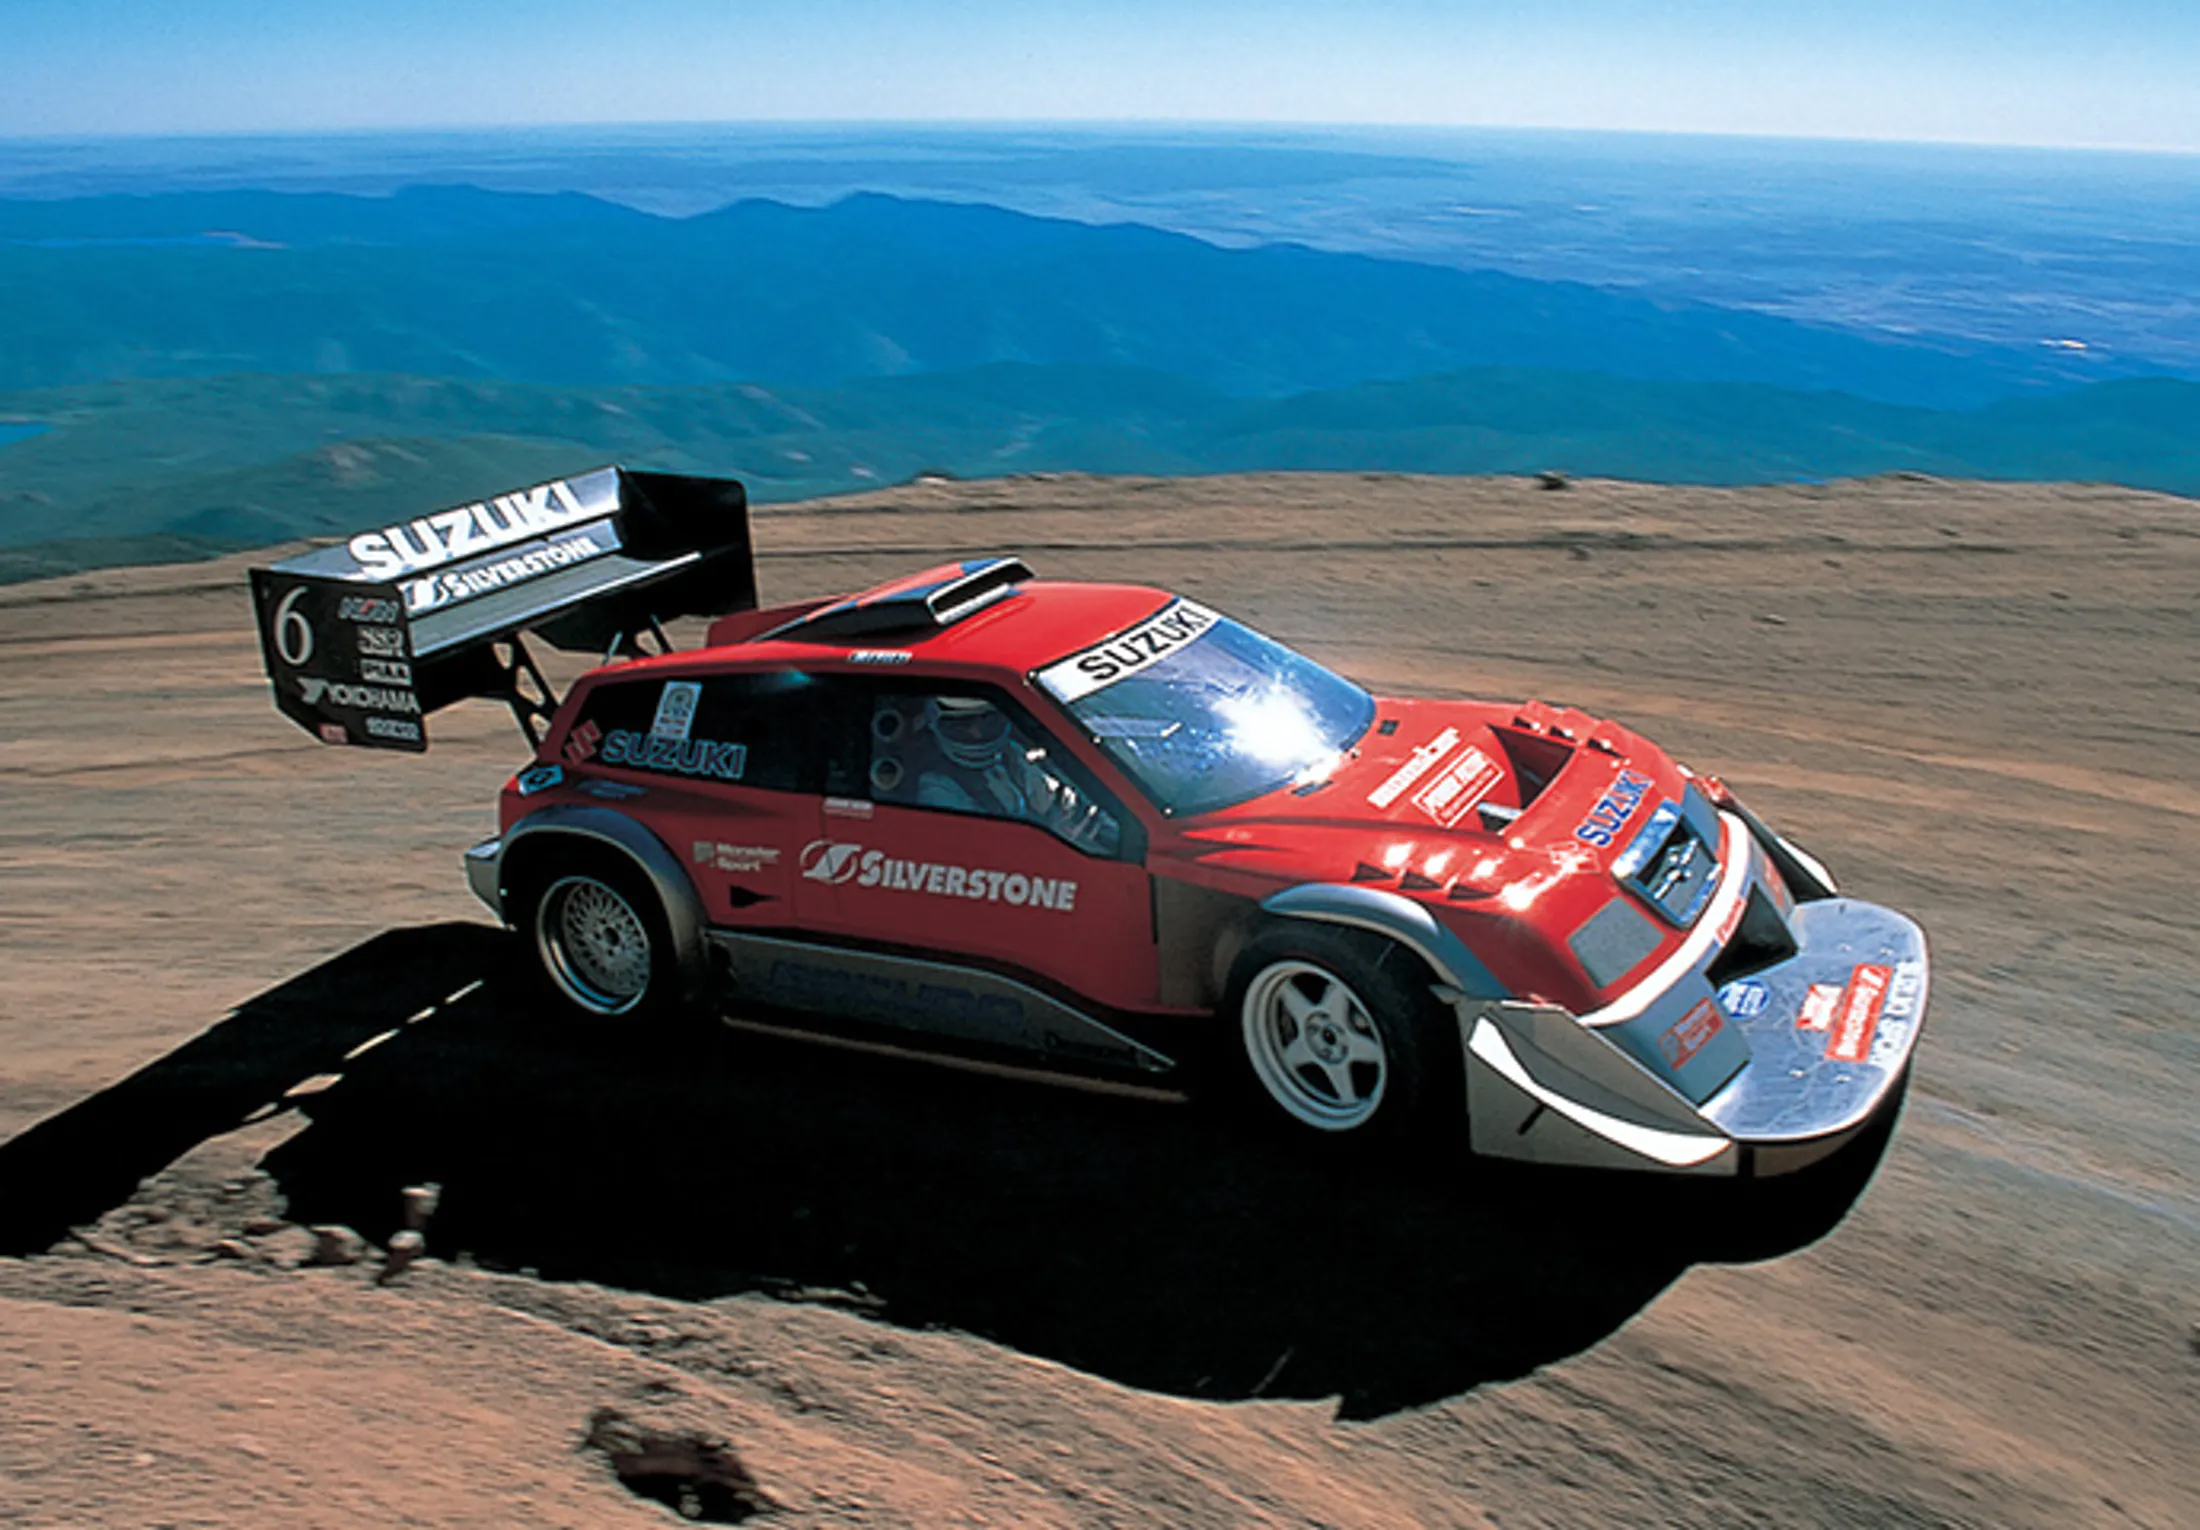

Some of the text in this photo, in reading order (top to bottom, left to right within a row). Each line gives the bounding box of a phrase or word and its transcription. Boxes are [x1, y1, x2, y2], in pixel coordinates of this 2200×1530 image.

[349, 481, 583, 578] SUZUKI
[443, 536, 601, 598] SILVERSTONE
[274, 585, 314, 665] 6
[1076, 604, 1211, 680] SUZUKI
[602, 729, 748, 778] SUZUKI
[1574, 769, 1654, 848] SUZUKI
[858, 850, 1077, 911] SILVERSTONE
